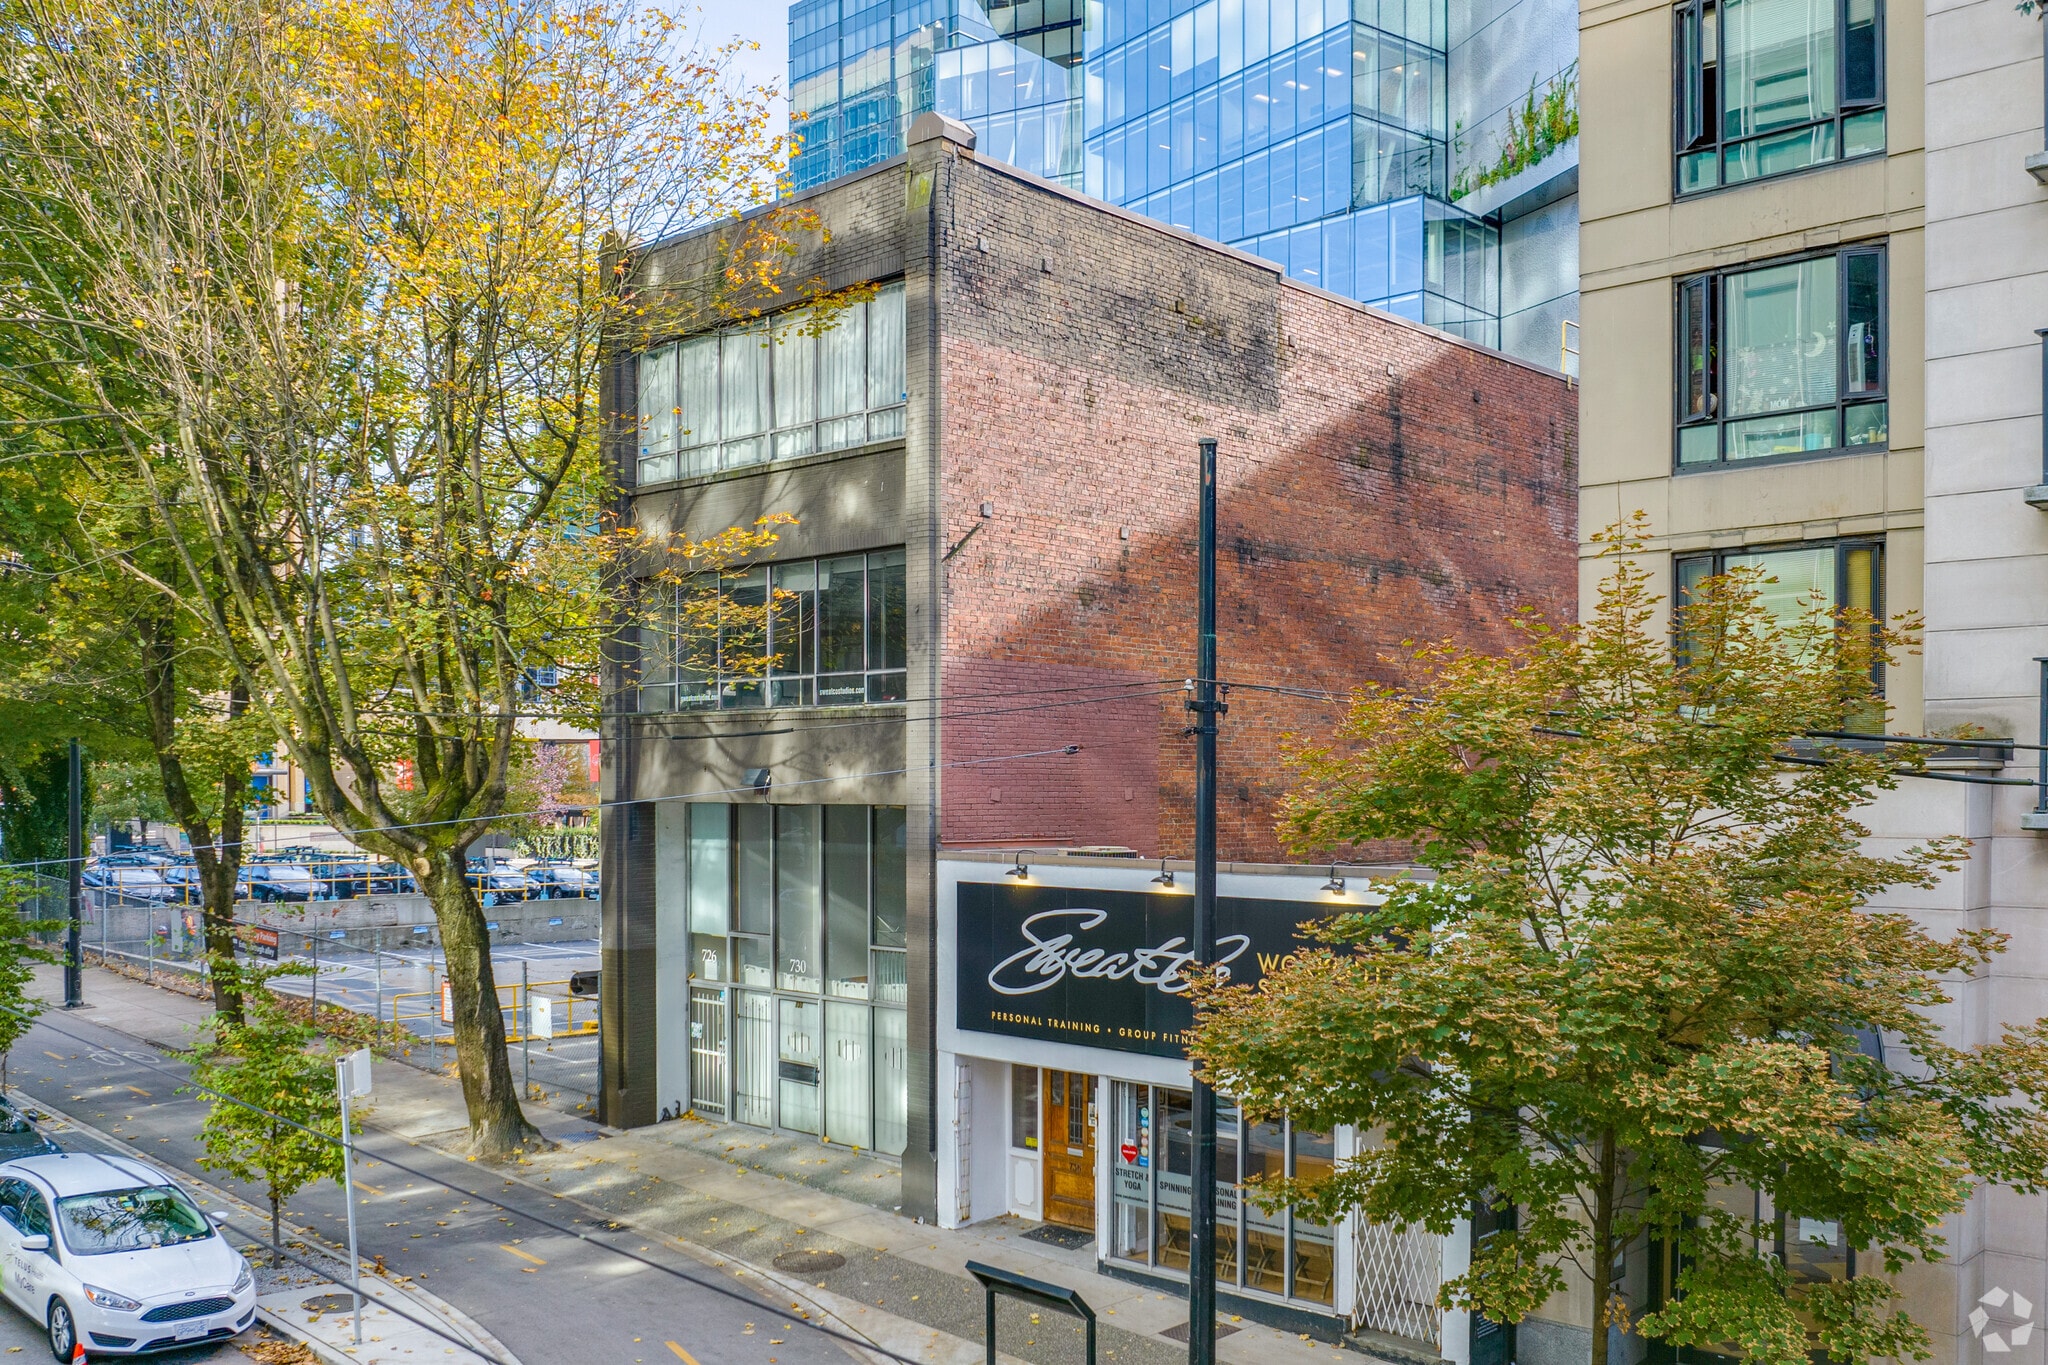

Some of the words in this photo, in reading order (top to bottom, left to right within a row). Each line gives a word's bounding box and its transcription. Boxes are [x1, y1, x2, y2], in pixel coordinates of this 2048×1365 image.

[701, 949, 717, 962] 726
[789, 959, 807, 973] 730
[991, 1010, 1042, 1026] PERSONAL
[1047, 1018, 1100, 1034] TRAINING
[1119, 1027, 1156, 1040] GROUP
[1163, 1033, 1194, 1044] FITN
[1115, 1167, 1144, 1181] STRETCH
[1124, 1180, 1142, 1191] YOGA
[1159, 1181, 1192, 1195] SPINNING
[1215, 1186, 1237, 1199] SONAL
